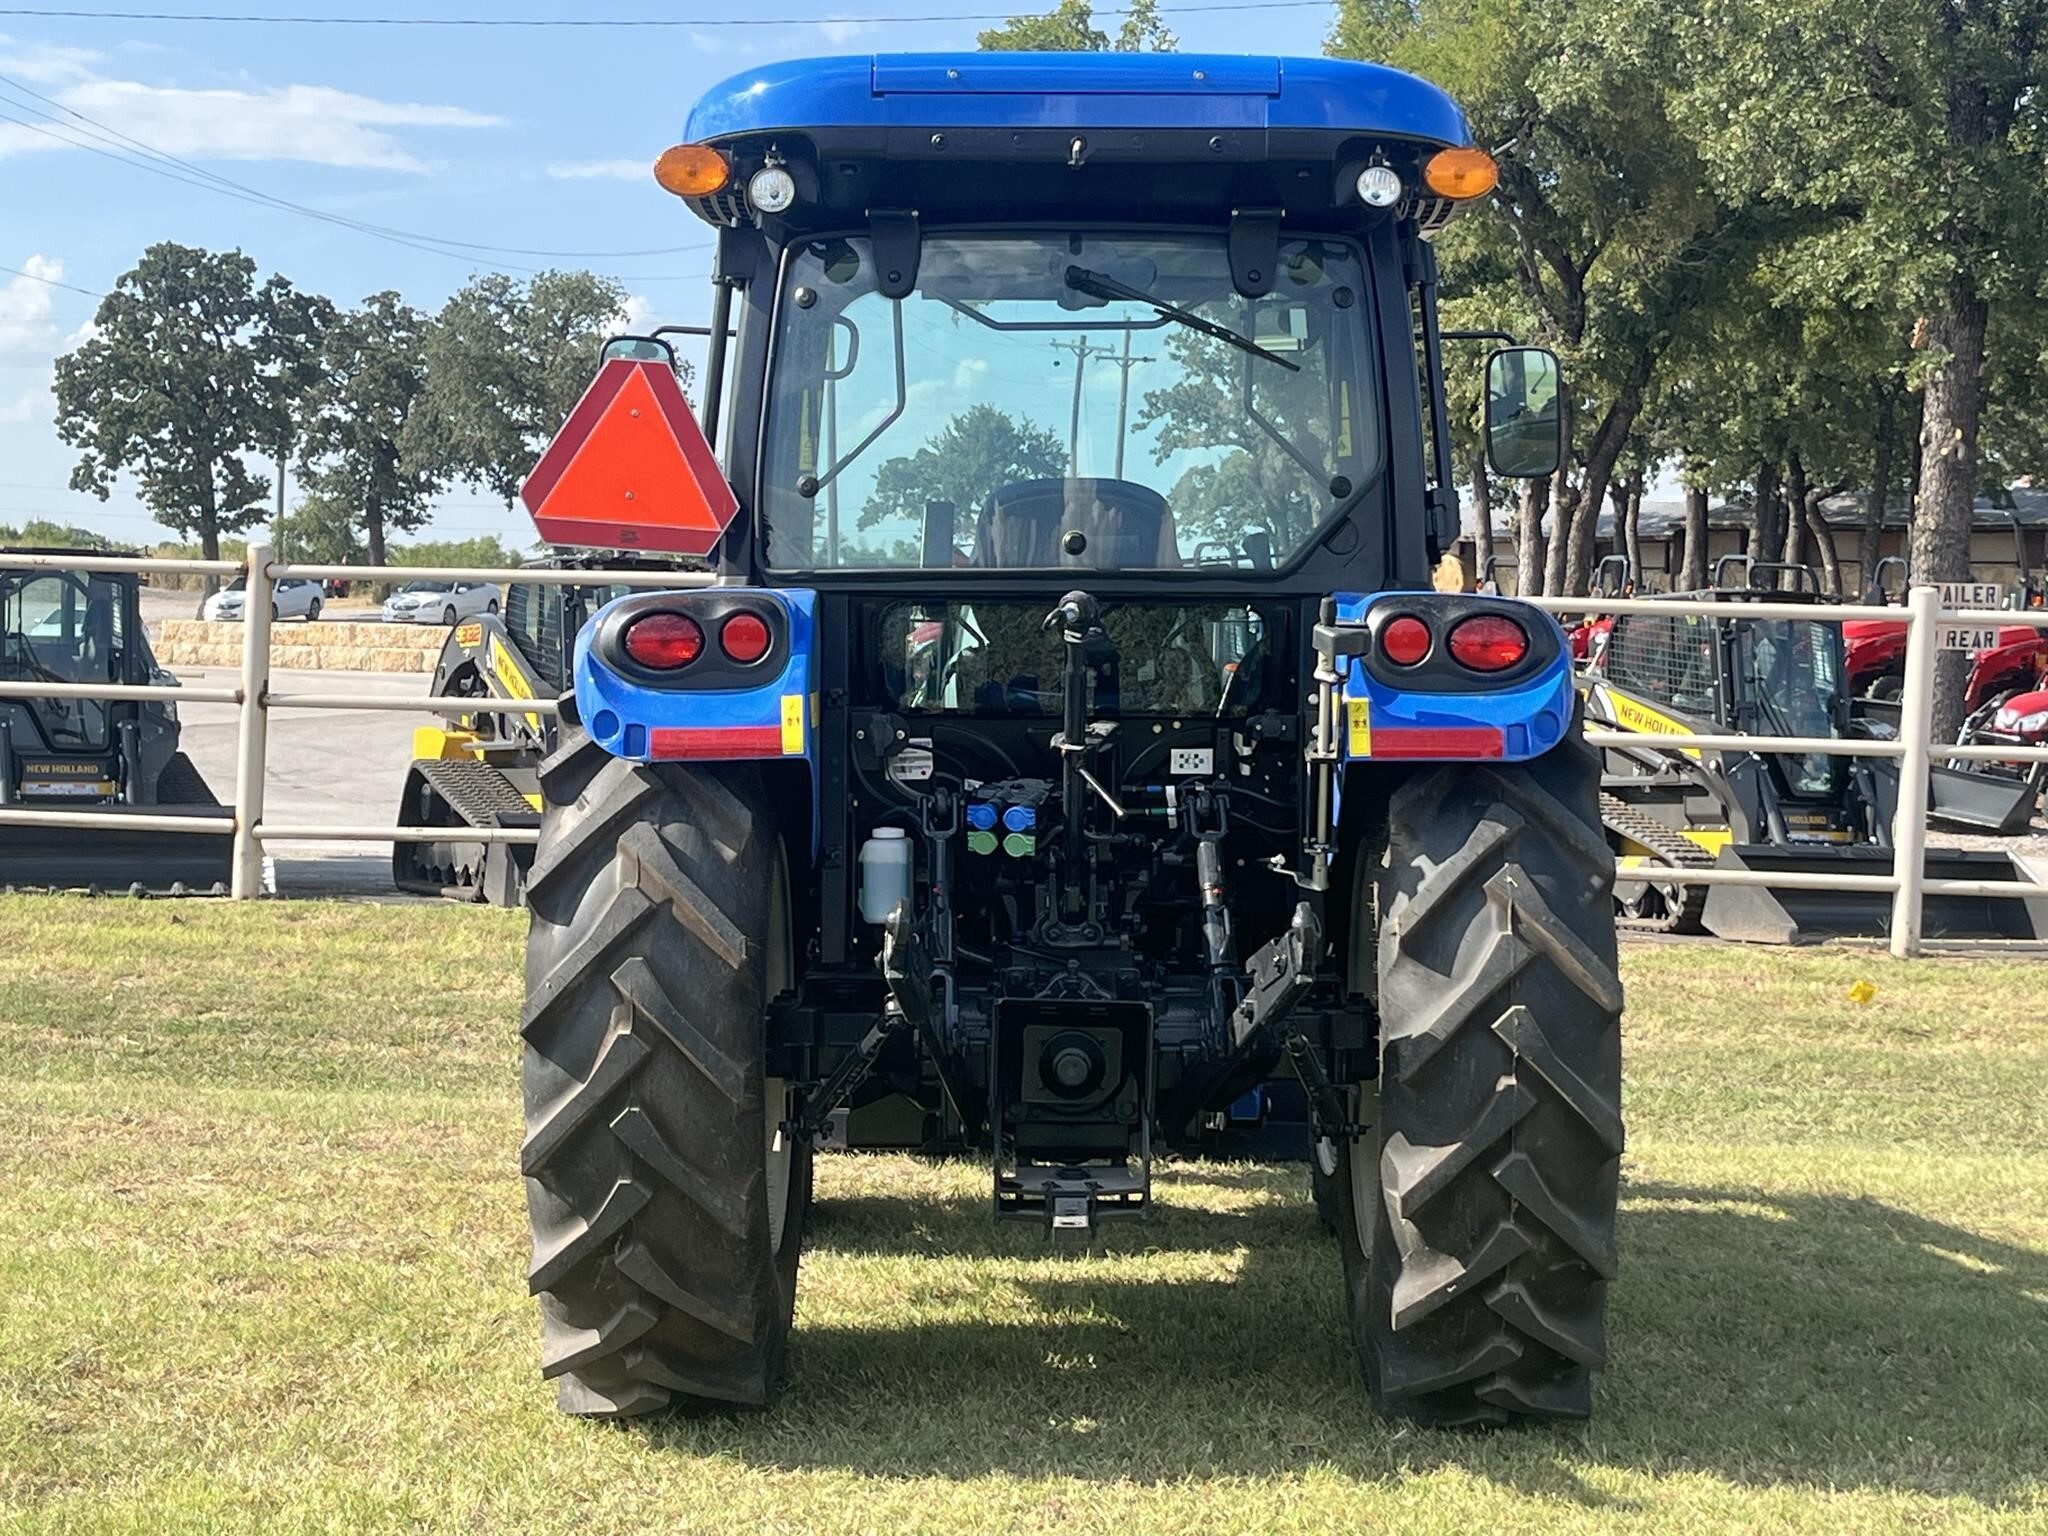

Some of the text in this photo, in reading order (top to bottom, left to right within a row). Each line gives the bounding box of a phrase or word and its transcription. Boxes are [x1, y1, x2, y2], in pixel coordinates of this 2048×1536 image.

[1931, 584, 1996, 604] AILER
[1946, 630, 1994, 648] REAR
[1620, 703, 1687, 735] NEW HOLLA
[26, 764, 98, 774] NEW HOLLAND
